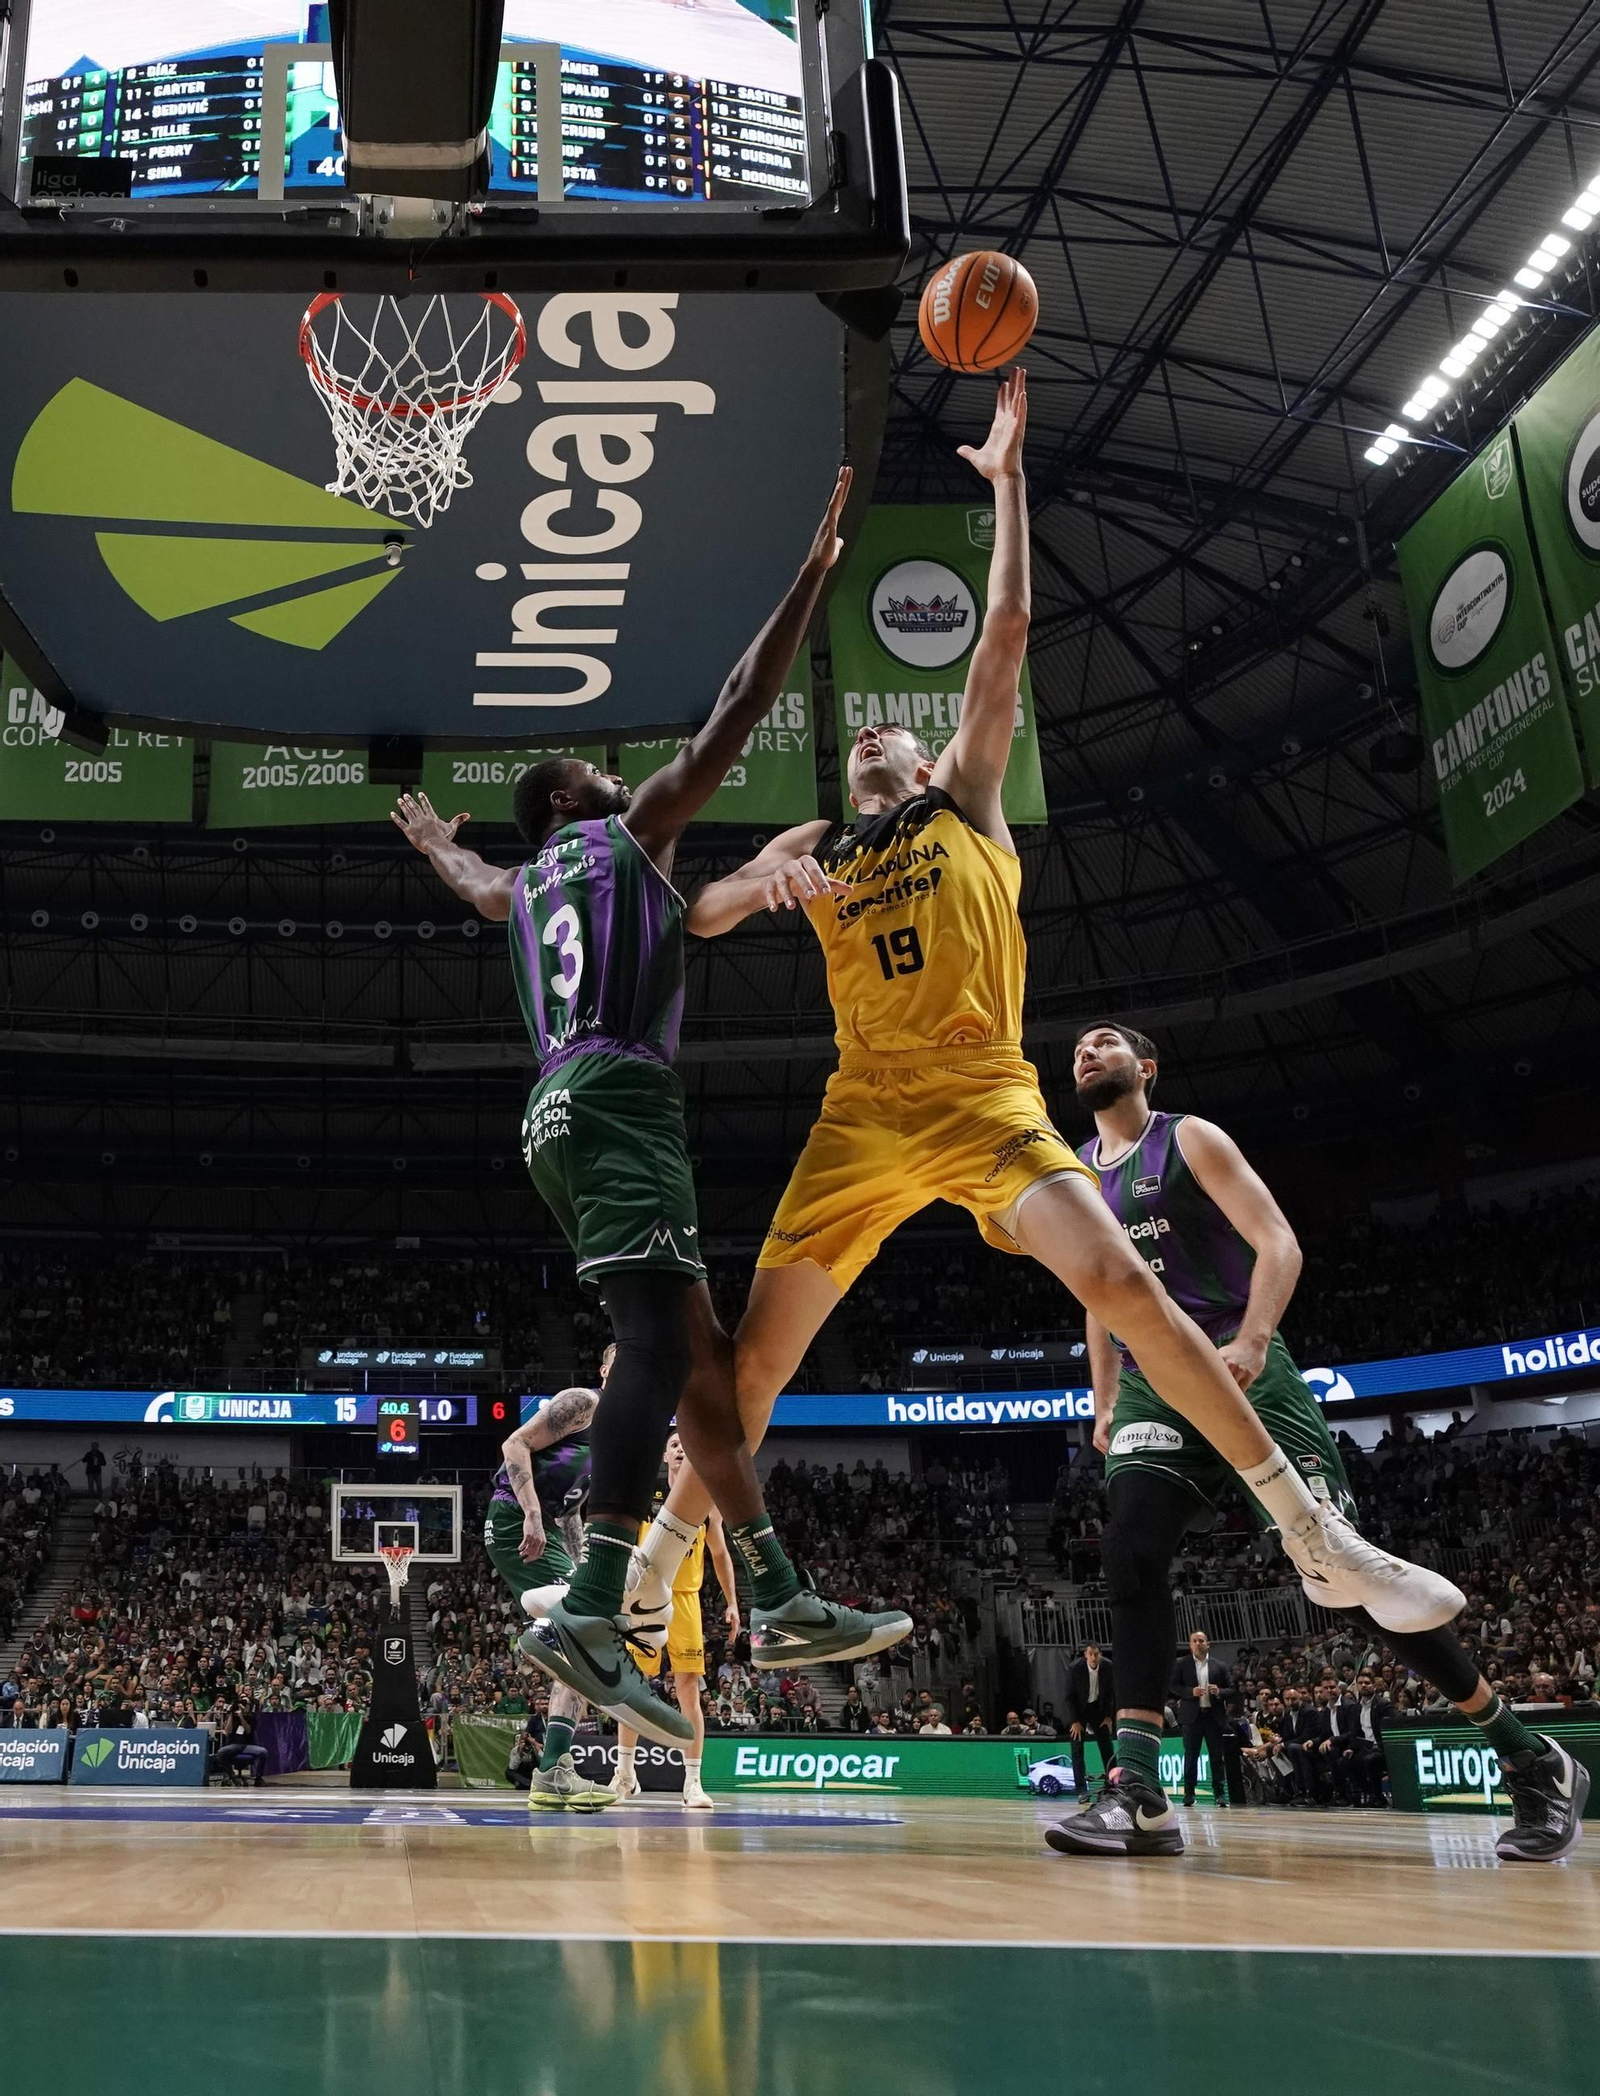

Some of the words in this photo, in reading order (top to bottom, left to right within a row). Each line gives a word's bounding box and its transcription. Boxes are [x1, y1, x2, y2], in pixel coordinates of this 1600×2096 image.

[561, 60, 599, 76] ÄMER
[643, 73, 650, 83] 1
[655, 74, 664, 84] F
[673, 76, 683, 87] 3
[62, 79, 70, 90] 0
[73, 77, 82, 88] F
[126, 88, 141, 100] 11
[154, 81, 205, 97] CARTER
[60, 100, 67, 109] 1
[71, 97, 80, 108] F
[90, 94, 98, 105] 0
[561, 83, 609, 98] IPALDO
[643, 93, 652, 104] 0
[656, 94, 665, 104] F
[674, 97, 683, 108] 2
[710, 81, 727, 95] 15
[738, 86, 787, 107] SASTRE
[57, 120, 66, 130] 0
[69, 118, 78, 129] F
[88, 114, 97, 125] 0
[124, 108, 142, 121] 14
[561, 102, 604, 119] ERTAS
[644, 114, 653, 124] 0
[656, 115, 665, 125] F
[674, 117, 684, 129] 2
[151, 123, 190, 138] TILLIE
[561, 123, 606, 140] CRUBB
[644, 134, 654, 145] 0
[657, 136, 666, 146] F
[675, 138, 686, 150] 2
[711, 123, 727, 136] 21
[57, 141, 63, 151] 1
[67, 138, 76, 149] F
[86, 135, 95, 146] 0
[149, 144, 193, 159] PERRY
[645, 155, 654, 166] 0
[658, 157, 667, 167] F
[675, 159, 686, 170] 0
[712, 143, 730, 157] 35
[741, 148, 792, 169] GUERRA
[37, 170, 77, 189] liga
[147, 166, 182, 180] SIMA
[242, 162, 248, 172] 1
[562, 166, 596, 181] OSTA
[645, 176, 655, 187] 0
[658, 178, 668, 188] F
[676, 180, 687, 192] 0
[713, 164, 731, 178] 42
[472, 292, 717, 707] Unicaja
[885, 611, 926, 622] FINAL
[927, 611, 964, 622] FOUR
[844, 692, 1025, 728] CAMPEOS
[1432, 652, 1551, 780] CAMPEONES
[758, 732, 808, 752] REY
[1440, 770, 1463, 793] FIBA
[1465, 698, 1555, 774] INTERCONTINENTAL
[1489, 751, 1505, 771] CUP
[64, 761, 122, 782] 2005
[242, 763, 364, 789] 2005/2006
[1483, 768, 1527, 817] 2024
[881, 893, 931, 913] emociones
[543, 904, 583, 999] 3
[871, 925, 925, 981] 19
[532, 1089, 572, 1120] COSTA
[531, 1116, 543, 1138] DEL
[544, 1107, 571, 1124] SOL
[1123, 1216, 1171, 1240] icaja
[392, 1351, 426, 1360] Fundación
[392, 1358, 417, 1366] Unicaja
[450, 1352, 484, 1360] Fundación
[450, 1358, 475, 1367] Unicaja
[929, 1352, 964, 1363] Unicaja
[1008, 1349, 1044, 1360] Unicaja
[219, 1399, 292, 1418] UNICAJA
[335, 1397, 357, 1422] 15
[380, 1402, 410, 1414] 40.6
[418, 1399, 452, 1421] 1.0
[492, 1402, 505, 1420] 6
[887, 1390, 1095, 1424] holidayworld
[390, 1419, 406, 1442] 6
[1118, 1424, 1179, 1444] amadesa
[392, 1445, 417, 1454] Unicaja
[1302, 1460, 1317, 1468] acb
[737, 1536, 768, 1577] UNICAJA
[0, 1739, 59, 1754] ndación
[119, 1740, 200, 1755] Fundación
[0, 1755, 34, 1772] icaja
[118, 1755, 176, 1773] Unicaja
[373, 1752, 415, 1767] Unicaja
[734, 1746, 900, 1788] Europcar
[1415, 1738, 1502, 1804] Europ
